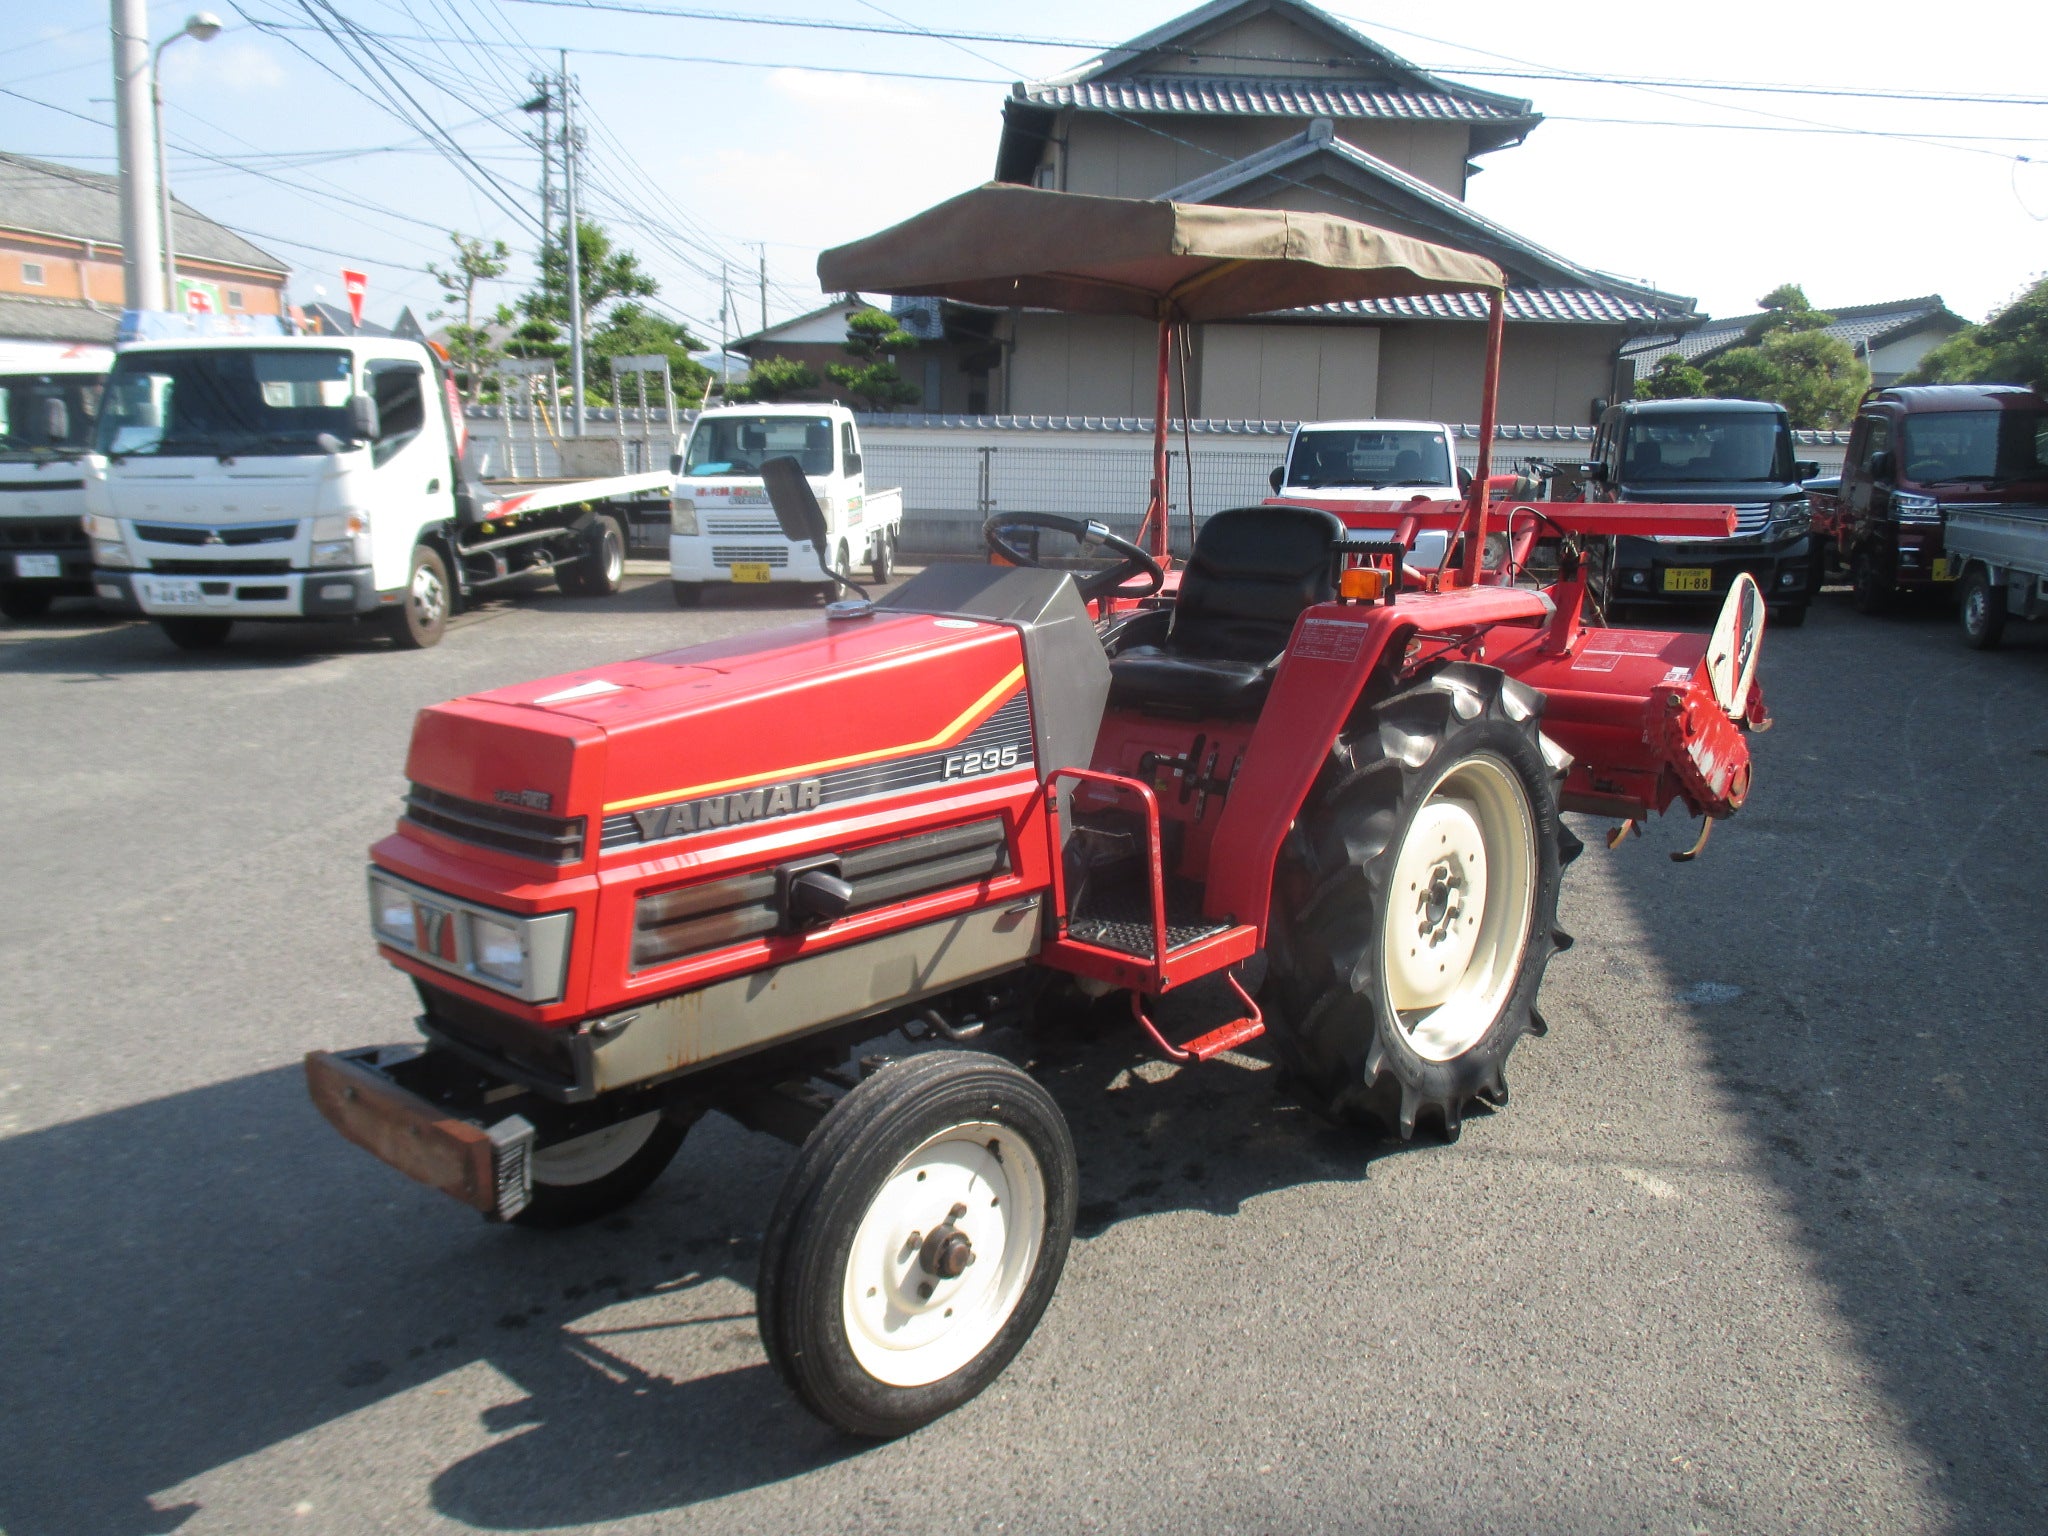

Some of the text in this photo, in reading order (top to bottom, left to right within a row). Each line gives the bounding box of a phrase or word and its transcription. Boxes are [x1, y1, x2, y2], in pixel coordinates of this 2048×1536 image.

[1675, 577, 1708, 590] 11-88
[943, 744, 1019, 782] F235
[633, 778, 822, 840] YANMAR
